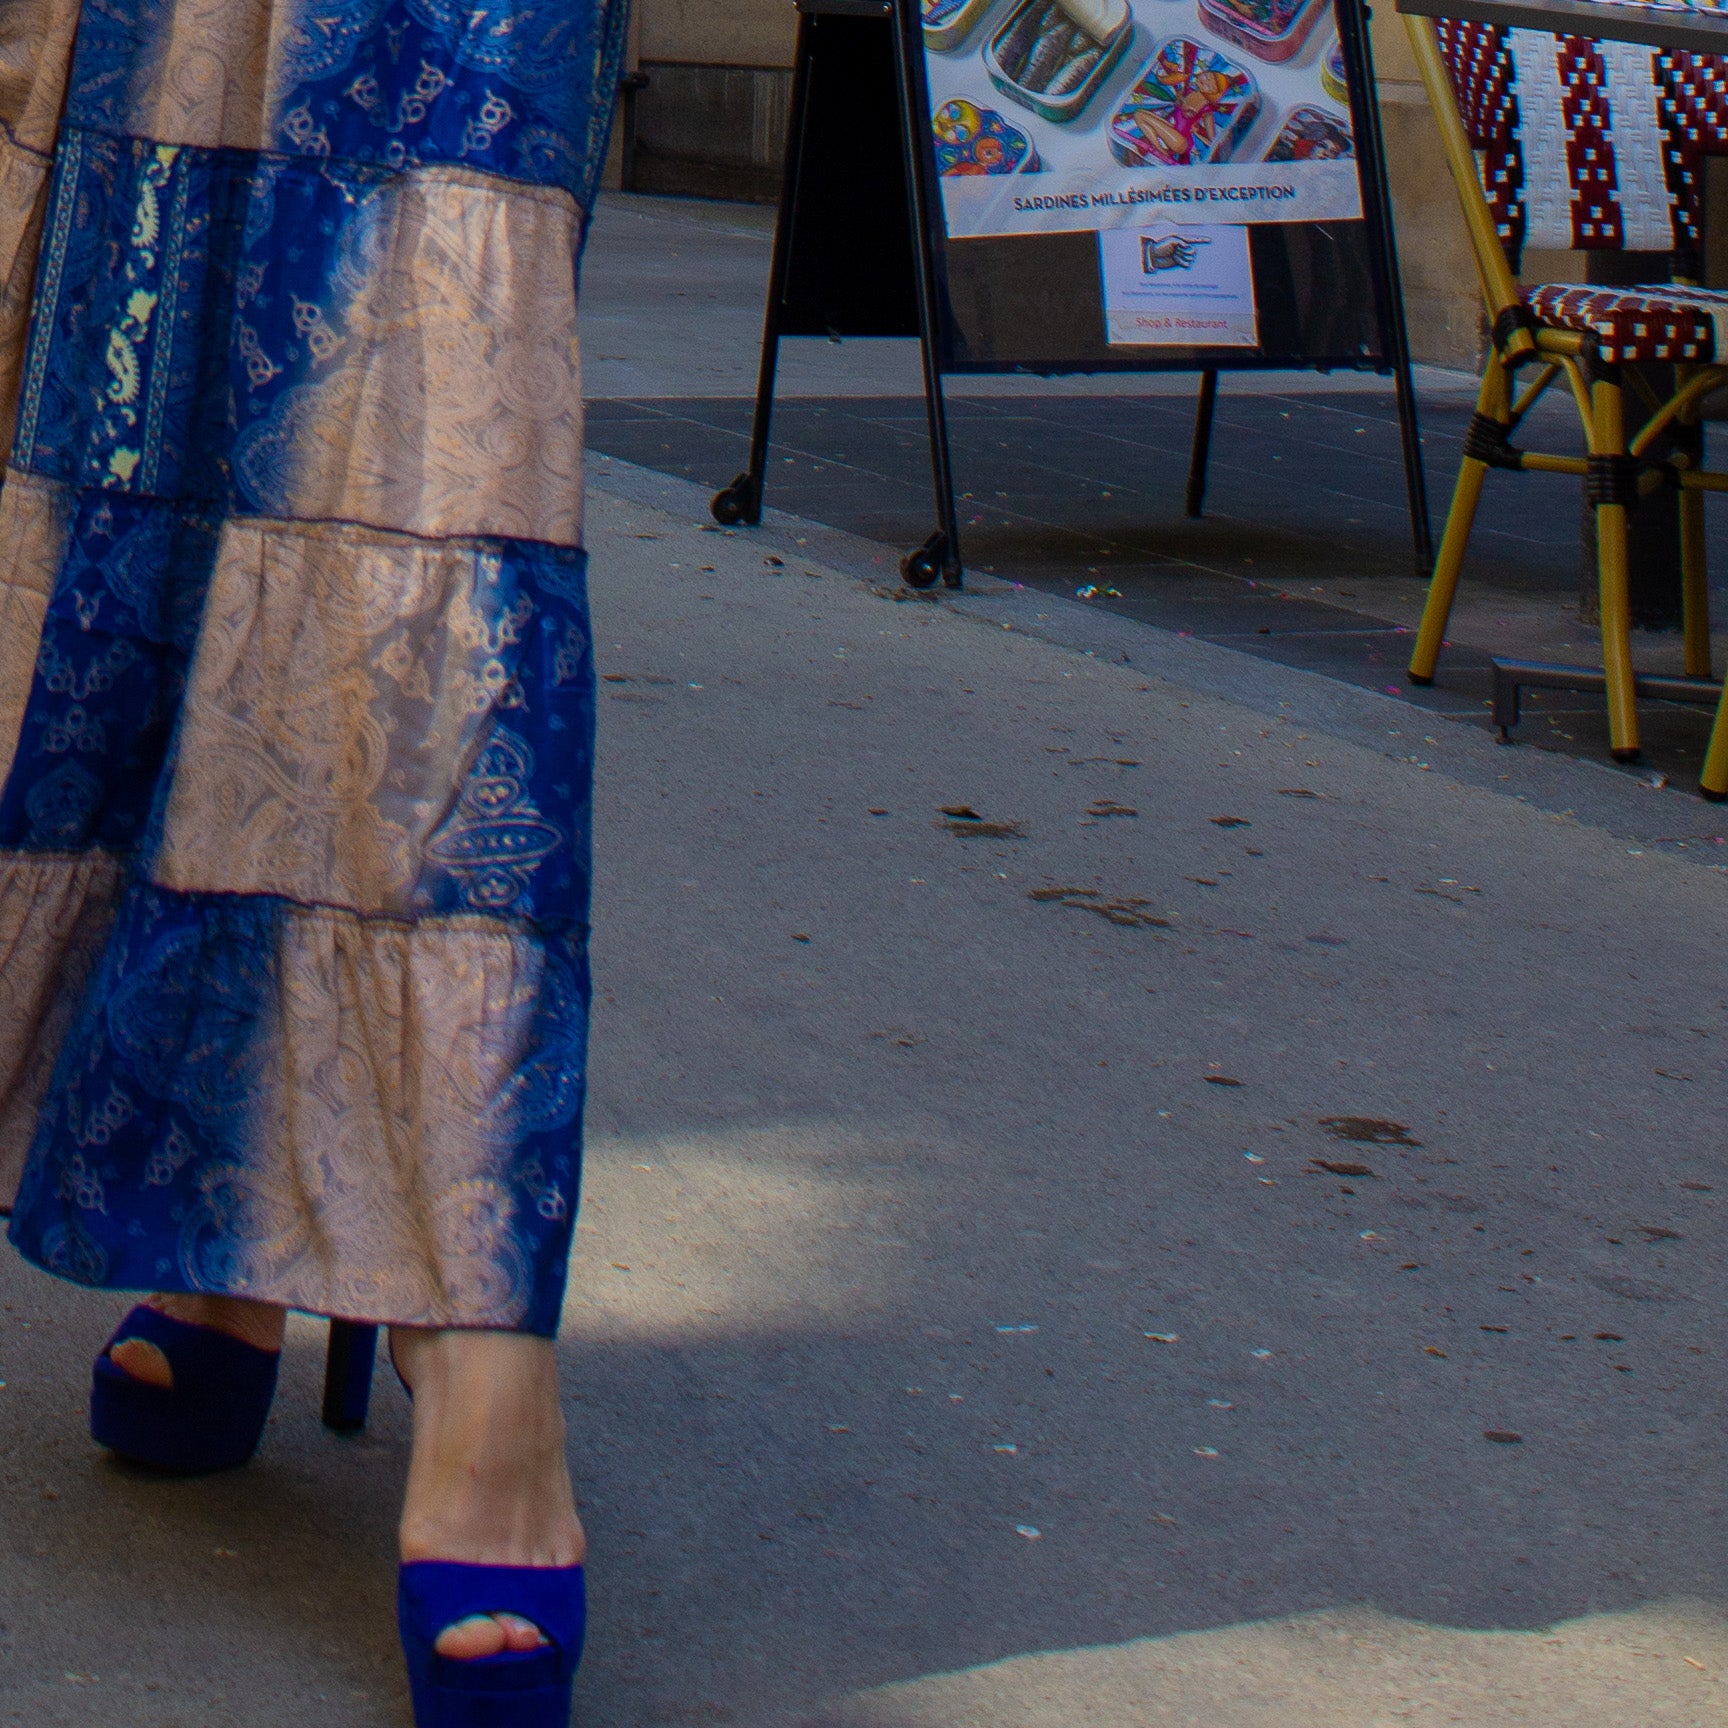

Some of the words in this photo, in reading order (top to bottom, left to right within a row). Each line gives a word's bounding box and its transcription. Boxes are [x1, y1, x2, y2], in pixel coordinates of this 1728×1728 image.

[1013, 193, 1089, 211] SARDINES
[1091, 184, 1190, 208] MILLÉSIMÉES
[1193, 184, 1296, 202] D'EXCEPTION
[1135, 316, 1161, 330] Shop
[1174, 317, 1228, 329] Restaurant
